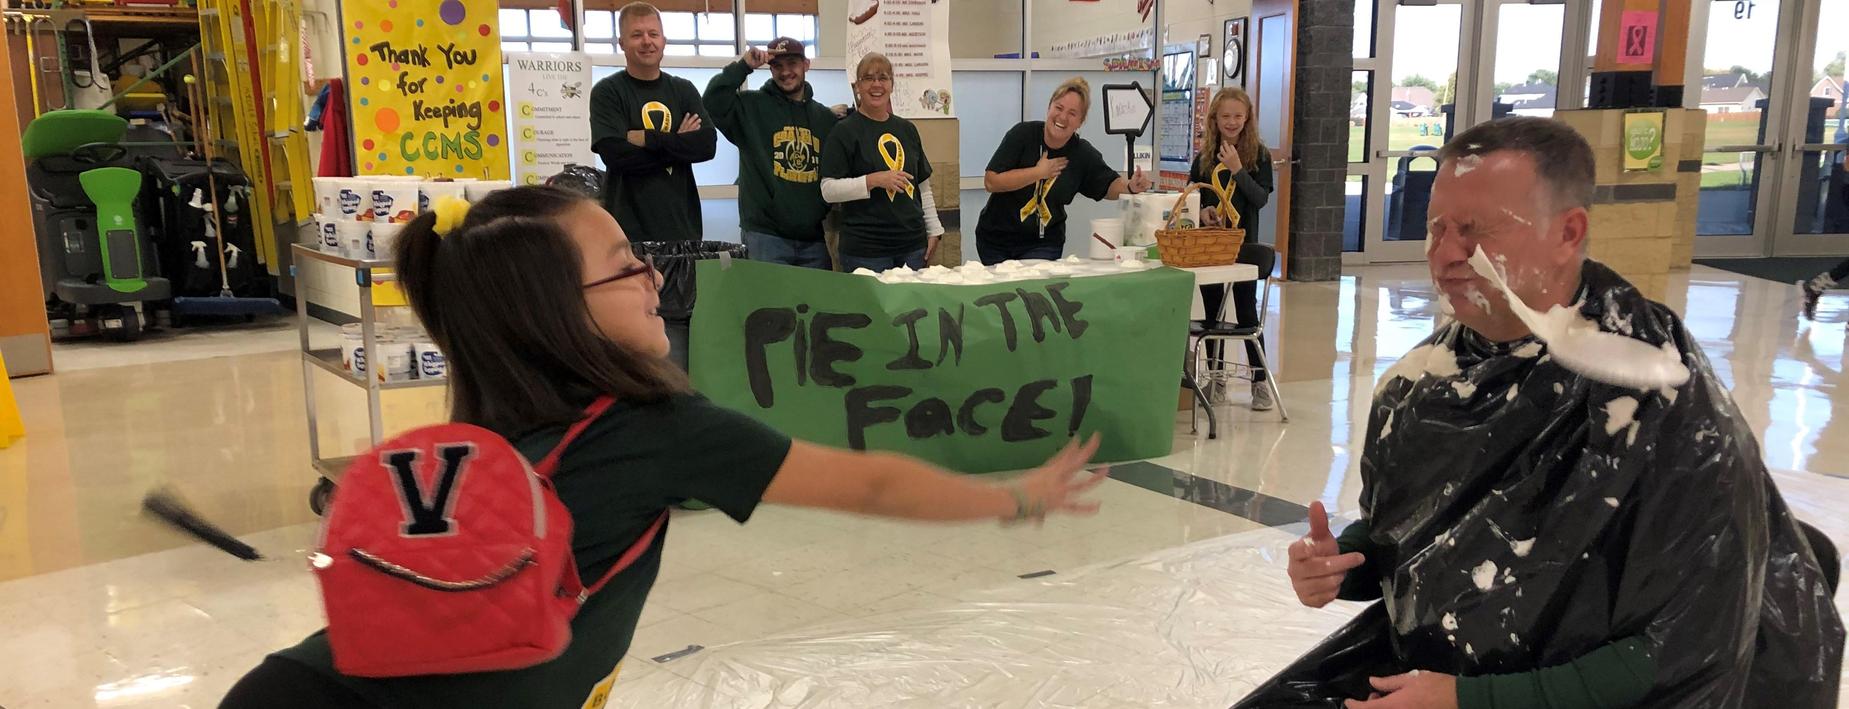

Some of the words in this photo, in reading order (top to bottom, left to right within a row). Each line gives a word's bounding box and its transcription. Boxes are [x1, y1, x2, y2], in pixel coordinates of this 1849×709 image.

[369, 41, 431, 67] Thank
[437, 42, 477, 70] You
[517, 59, 582, 72] WARRIORS
[396, 71, 428, 96] for
[528, 81, 535, 95] 4
[412, 98, 483, 131] Keeping
[399, 129, 483, 162] CCMS
[886, 302, 965, 371] IN
[973, 281, 1089, 353] THE
[380, 441, 479, 538] V
